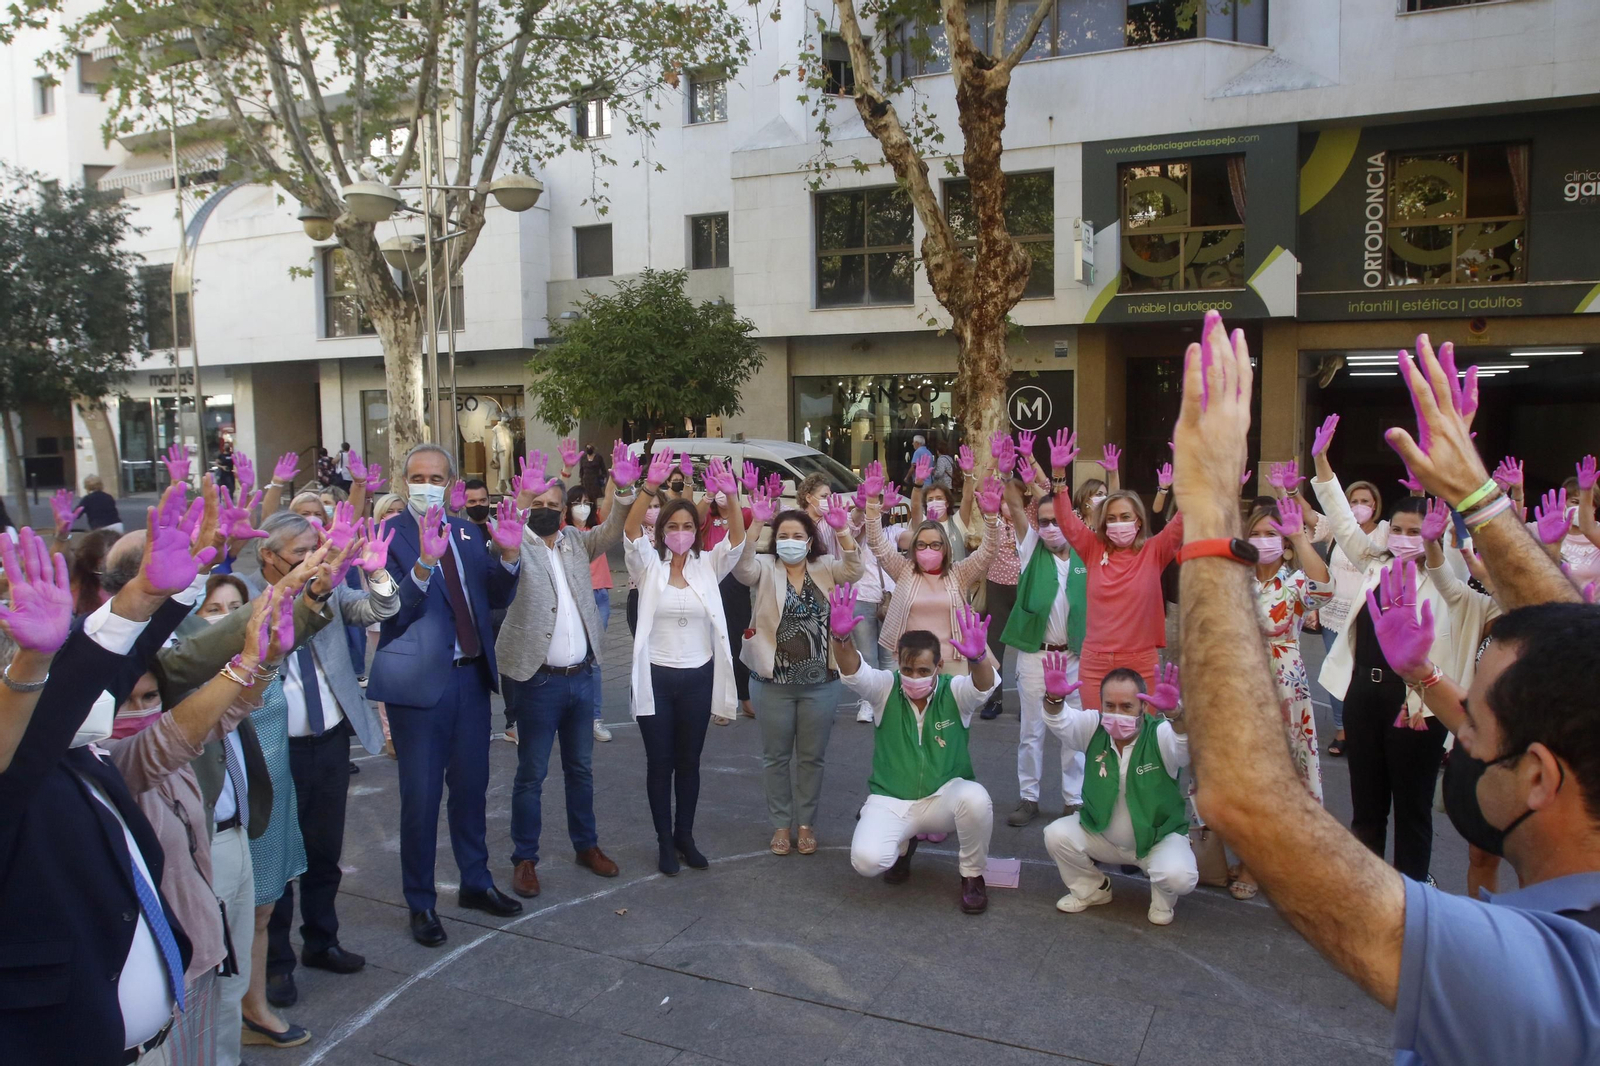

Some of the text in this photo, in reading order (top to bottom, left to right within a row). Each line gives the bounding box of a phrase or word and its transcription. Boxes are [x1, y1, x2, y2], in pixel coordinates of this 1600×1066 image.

[1106, 134, 1260, 154] www.ortodonciagarciaespejo.com
[1363, 152, 1385, 288] ORTODONCIA
[1127, 299, 1233, 314] invisible autoligado
[1348, 296, 1523, 313] infantil estética adultos
[150, 371, 194, 386] mara's
[838, 385, 940, 404] MANGO
[1016, 396, 1043, 421] M
